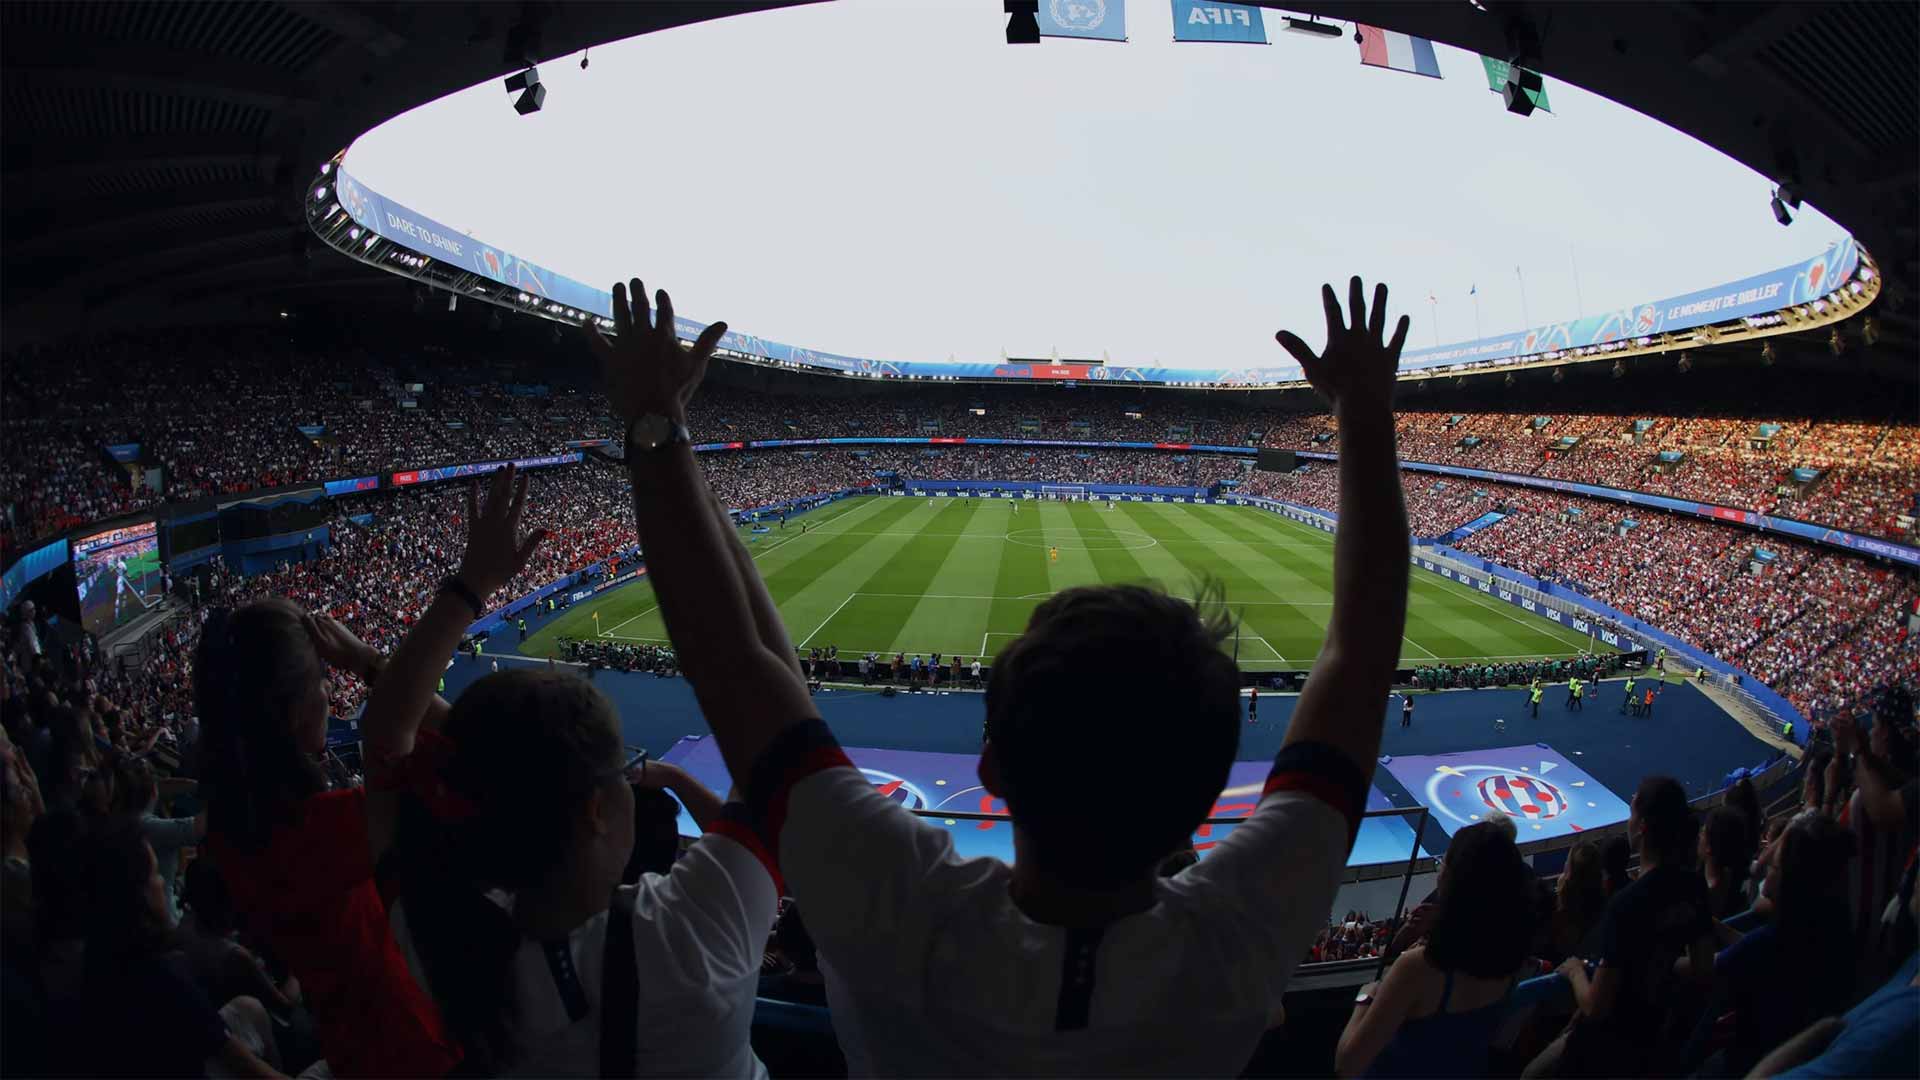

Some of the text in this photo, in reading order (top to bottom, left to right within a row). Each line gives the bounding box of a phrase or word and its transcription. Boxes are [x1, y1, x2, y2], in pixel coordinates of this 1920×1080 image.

[387, 212, 463, 257] DARE TO SHINE
[1668, 307, 1681, 320] LE
[1681, 297, 1723, 317] MOMENT
[1723, 294, 1737, 308] DE
[1500, 589, 1511, 602] VISA
[1521, 597, 1536, 612] VISA
[1546, 607, 1560, 622] VISA
[1573, 618, 1588, 634] VISA
[1601, 629, 1618, 646] VISA
